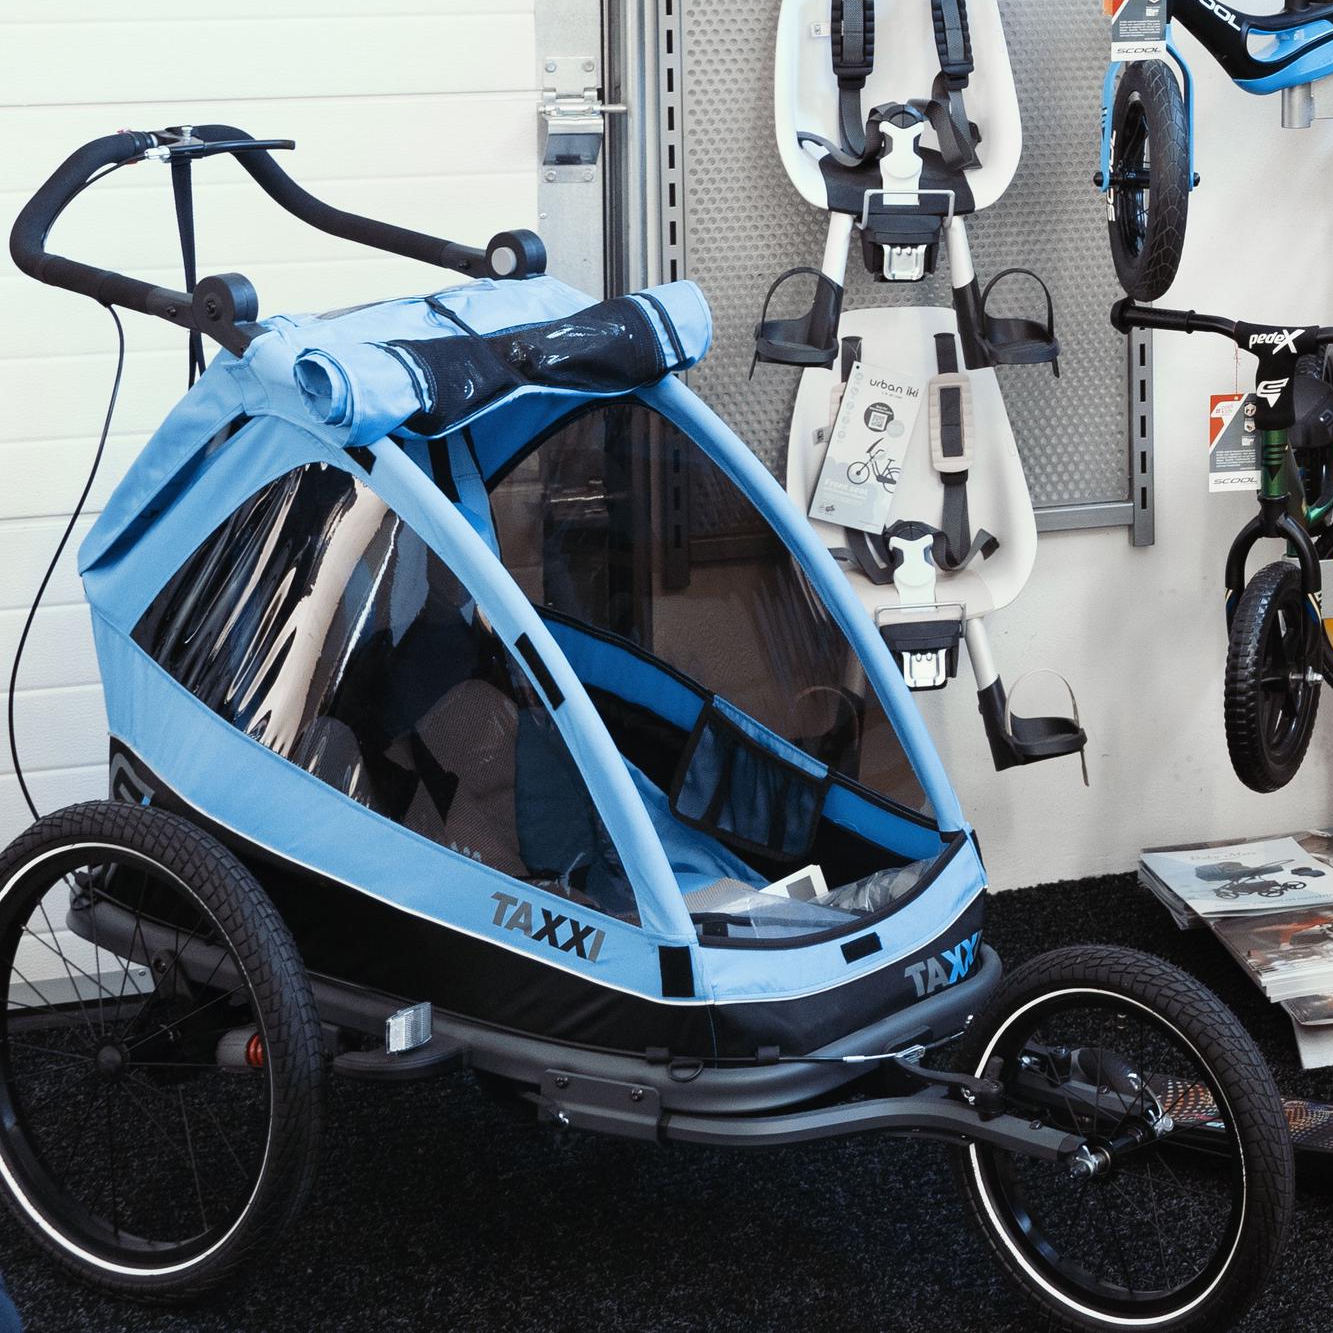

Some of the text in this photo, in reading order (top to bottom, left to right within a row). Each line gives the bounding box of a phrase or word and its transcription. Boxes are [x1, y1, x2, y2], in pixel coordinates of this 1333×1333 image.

[1115, 46, 1162, 56] SCOOL
[1249, 329, 1305, 354] pedeX
[869, 378, 920, 398] urban iki
[1212, 477, 1257, 487] SCOOL
[490, 891, 606, 963] TAXXI
